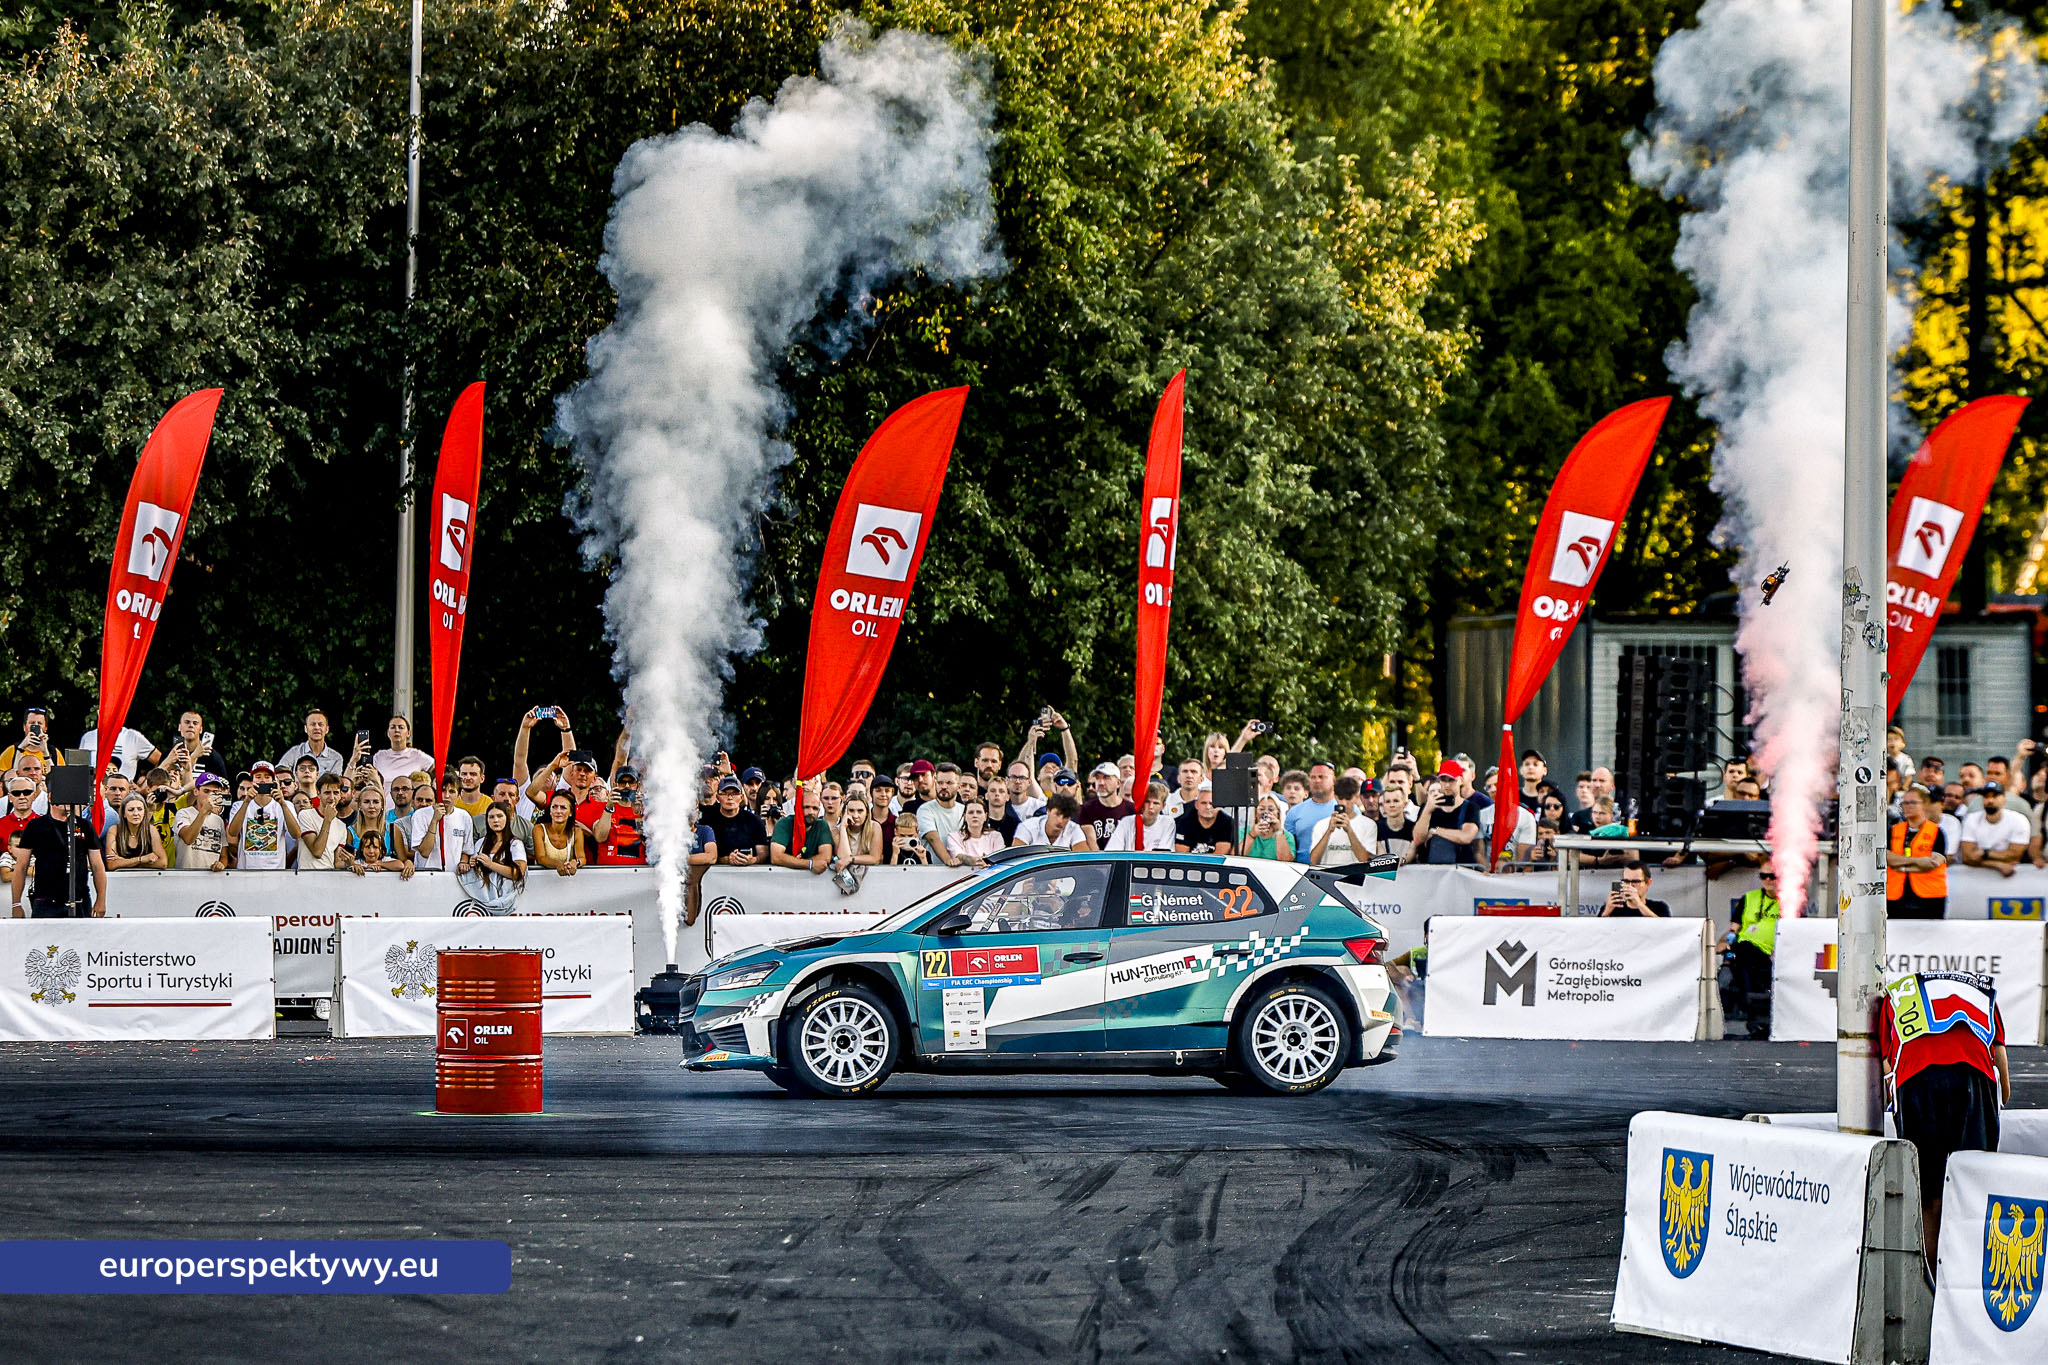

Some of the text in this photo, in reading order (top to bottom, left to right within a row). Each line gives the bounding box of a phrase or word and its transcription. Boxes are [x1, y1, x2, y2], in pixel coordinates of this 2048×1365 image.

[830, 588, 904, 618] ORLEN
[851, 619, 879, 638] OIL
[1218, 885, 1260, 919] 22
[87, 951, 196, 967] Ministerstwo
[925, 951, 948, 978] 22
[993, 953, 1023, 962] ORLEN
[1549, 957, 1625, 974] Górnośląsko
[974, 976, 1013, 985] Championship
[1110, 958, 1185, 985] HUN-Therm
[87, 972, 233, 992] Sportu i Turystyki
[1547, 989, 1615, 1005] Metropolia
[473, 1025, 513, 1035] ORLEN
[473, 1036, 489, 1045] OIL
[1728, 1162, 1830, 1205] Województwo
[1725, 1201, 1778, 1246] Śląskie
